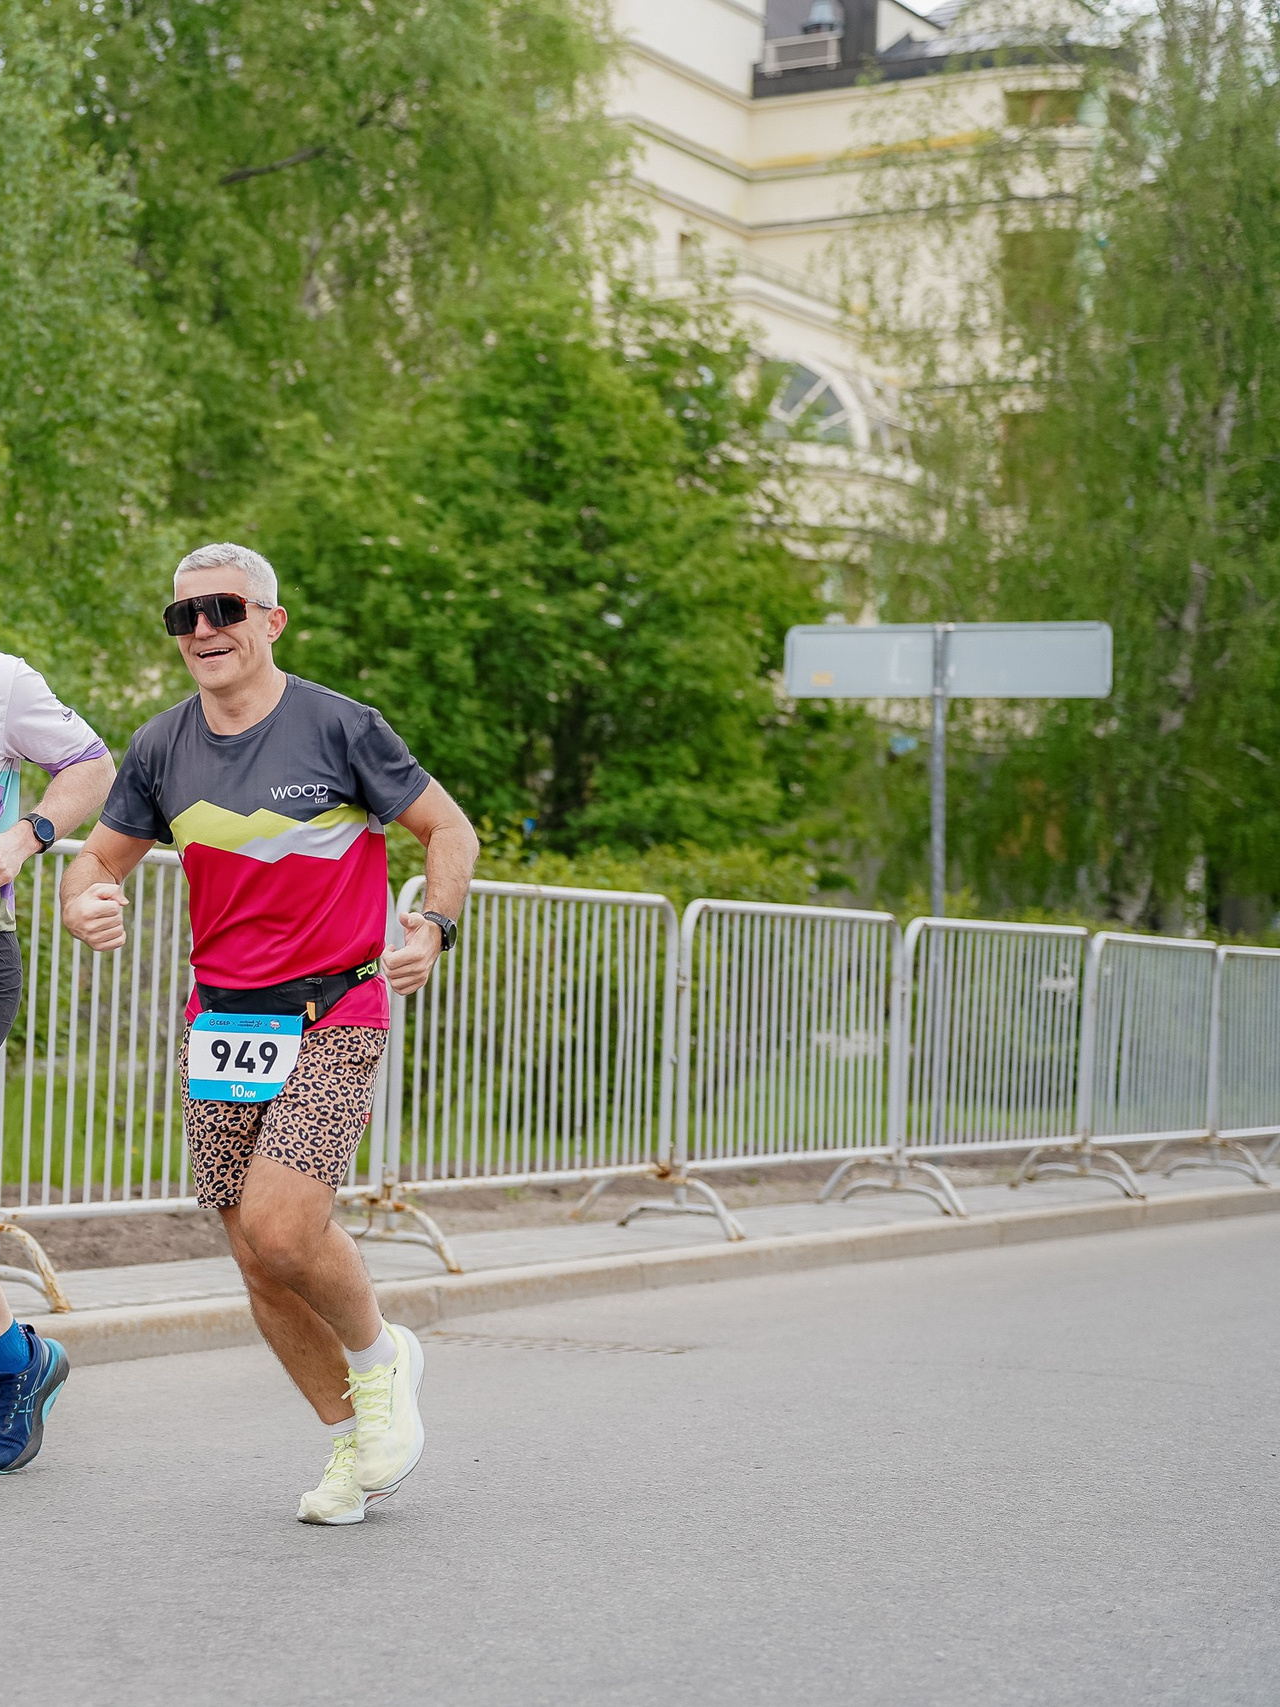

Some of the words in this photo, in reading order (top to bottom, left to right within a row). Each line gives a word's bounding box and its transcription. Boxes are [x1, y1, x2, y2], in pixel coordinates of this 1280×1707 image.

[270, 784, 329, 800] WOOD
[314, 795, 329, 804] trail
[210, 1039, 279, 1075] 949
